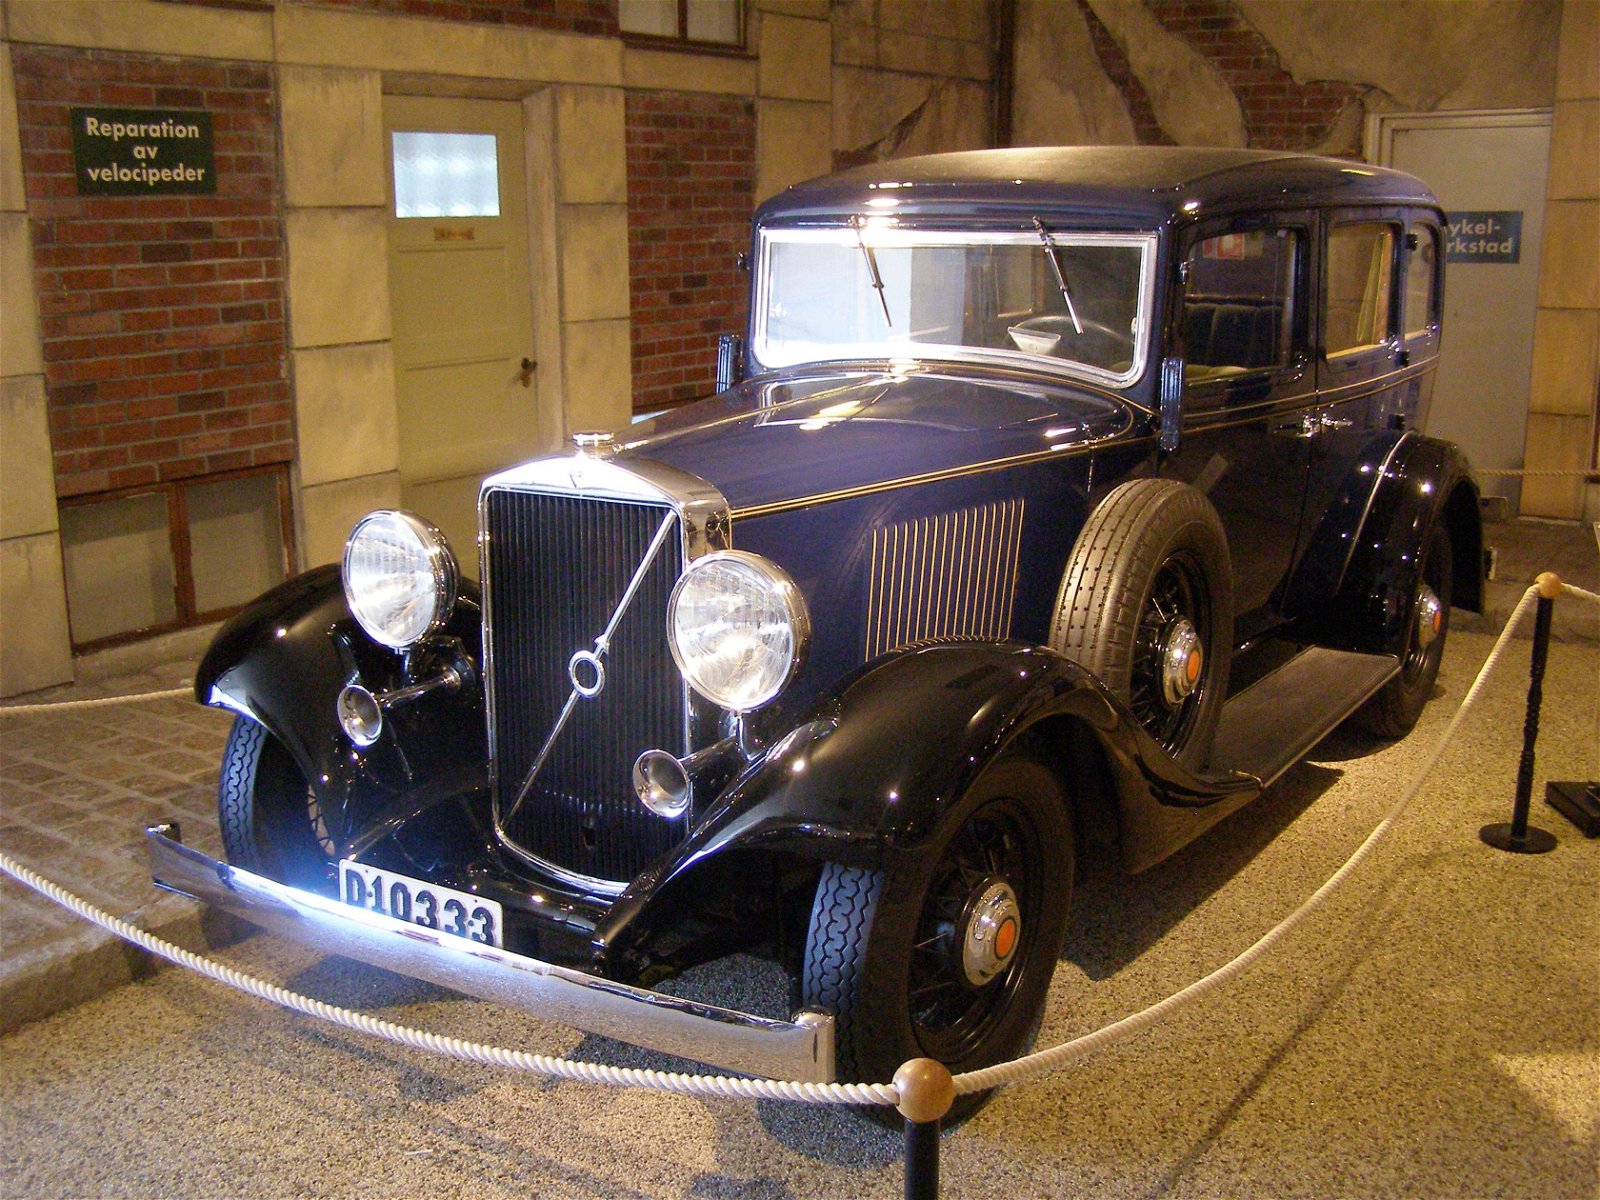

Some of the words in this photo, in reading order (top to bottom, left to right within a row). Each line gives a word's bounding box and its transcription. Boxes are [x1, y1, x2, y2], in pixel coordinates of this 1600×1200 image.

[86, 117, 199, 141] Reparation
[133, 145, 158, 159] av
[87, 162, 205, 186] velocipeder
[1446, 219, 1500, 237] ykel-
[1446, 238, 1513, 253] rkstad
